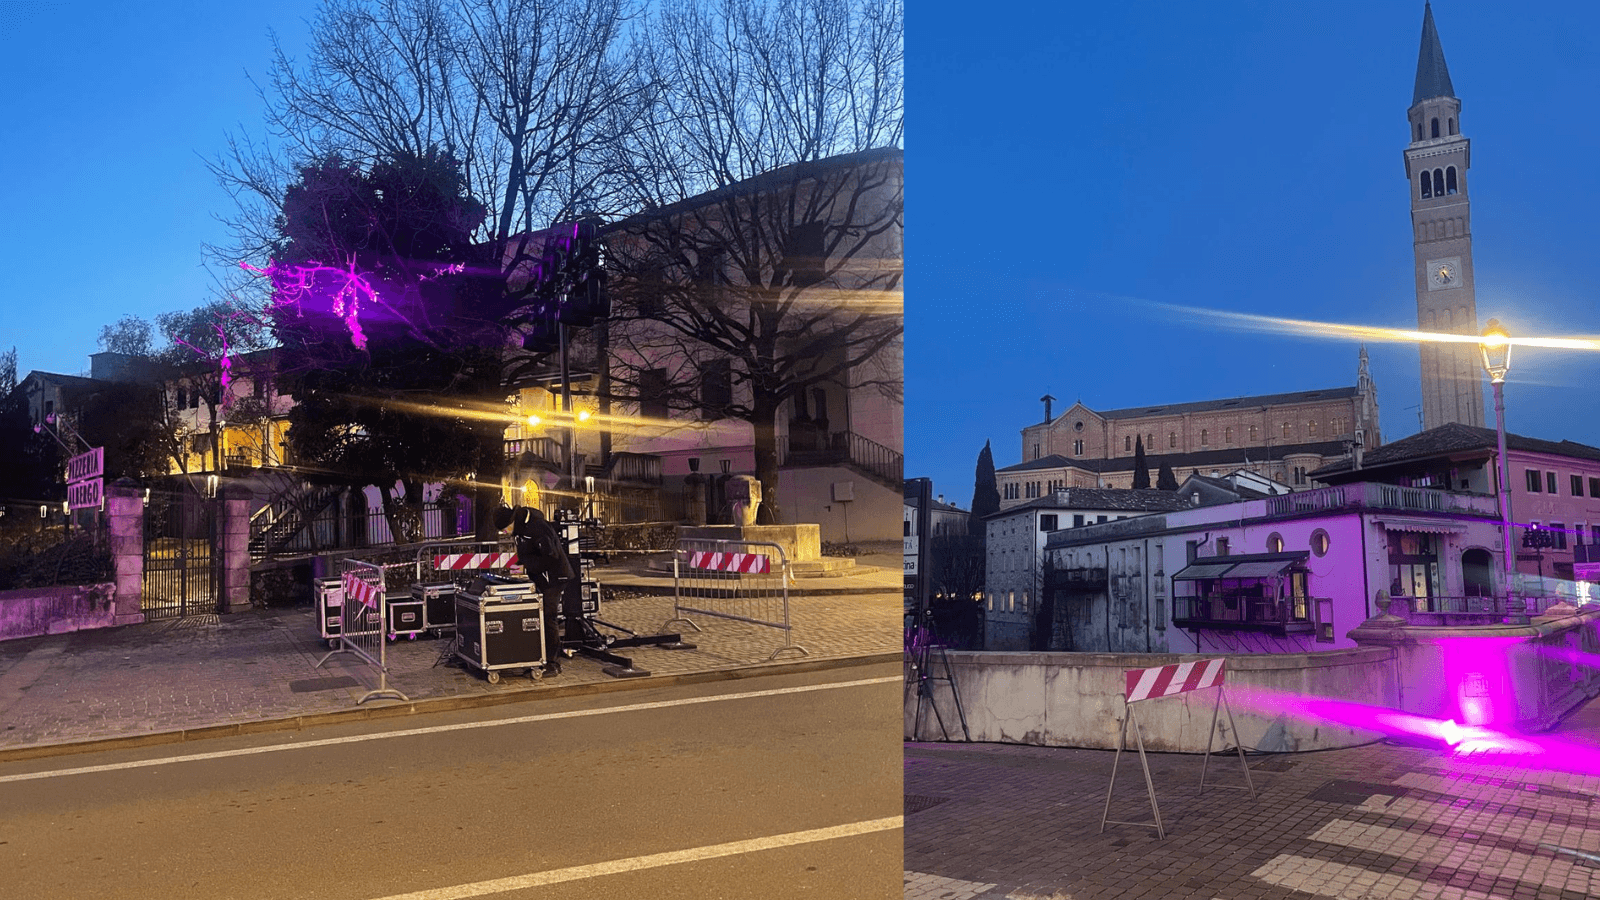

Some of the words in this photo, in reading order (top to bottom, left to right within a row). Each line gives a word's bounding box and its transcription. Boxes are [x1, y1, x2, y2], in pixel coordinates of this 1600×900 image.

[68, 451, 99, 480] PIZZERIA
[68, 482, 98, 506] ALBERGO
[903, 559, 915, 570] ina
